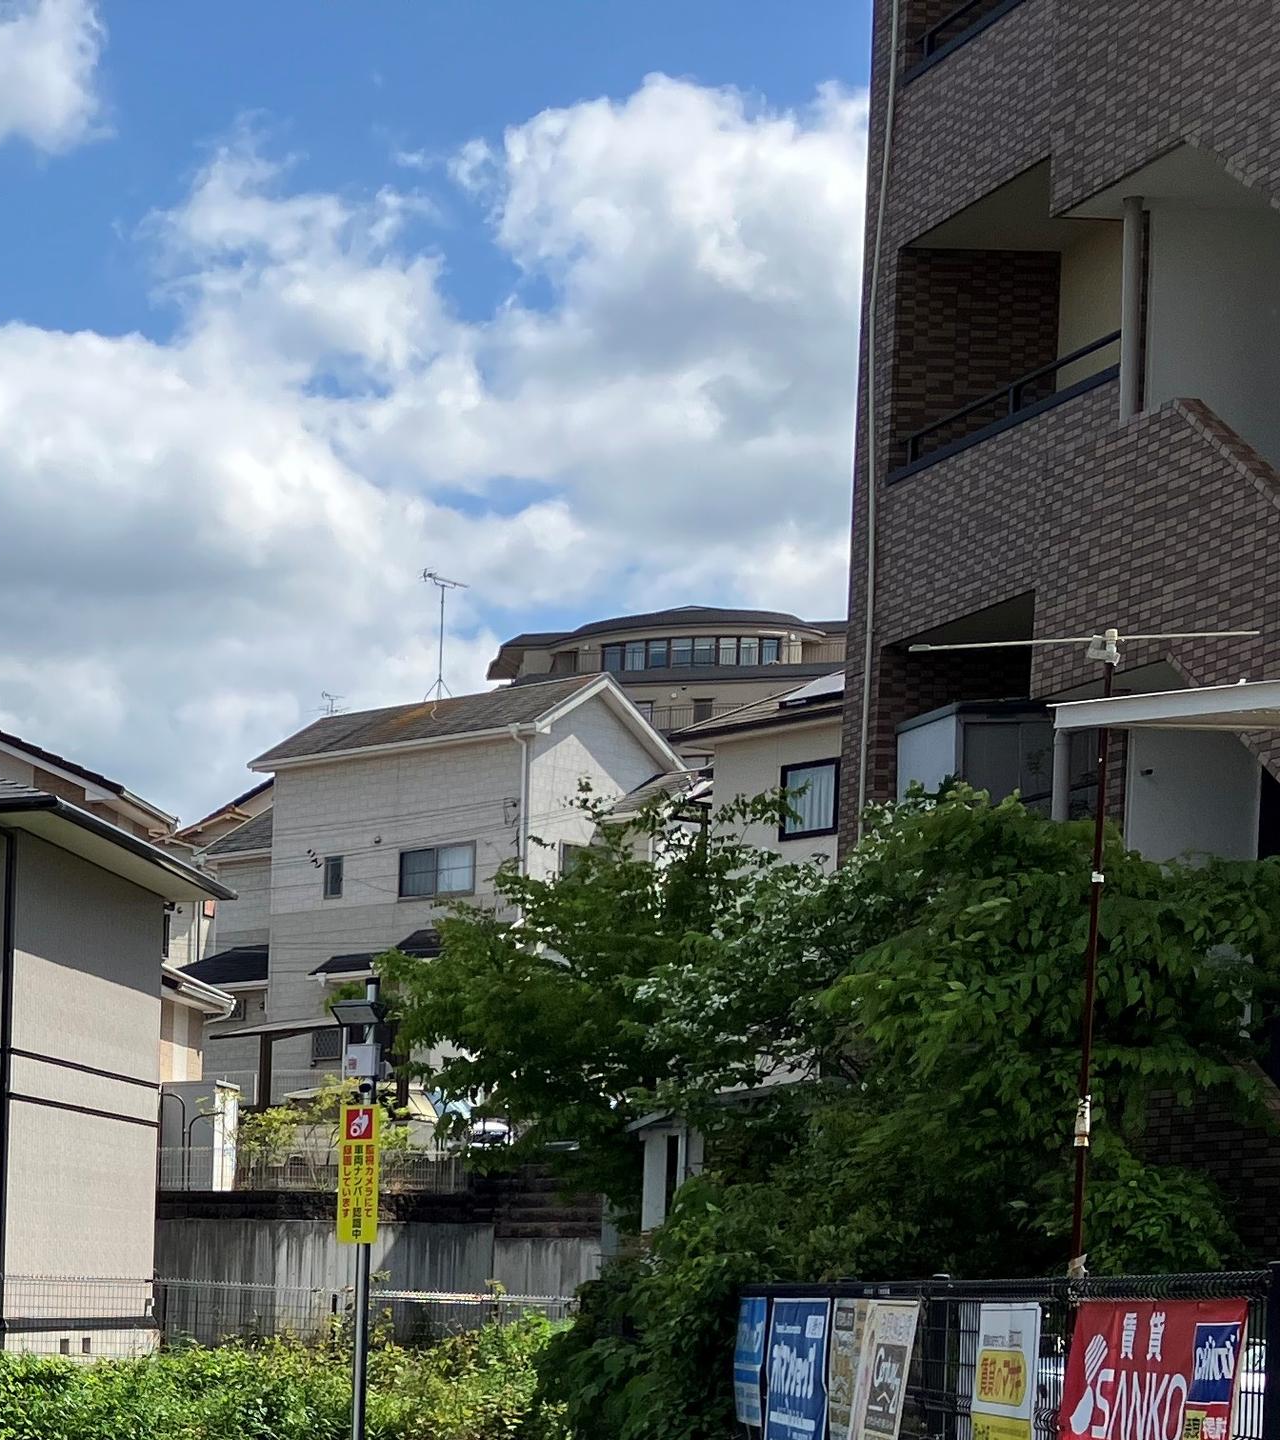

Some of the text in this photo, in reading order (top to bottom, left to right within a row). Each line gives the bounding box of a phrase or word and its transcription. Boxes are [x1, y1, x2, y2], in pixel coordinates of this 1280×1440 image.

[364, 1144, 375, 1218] 監視カメラにて
[1120, 1311, 1166, 1362] 賃貸
